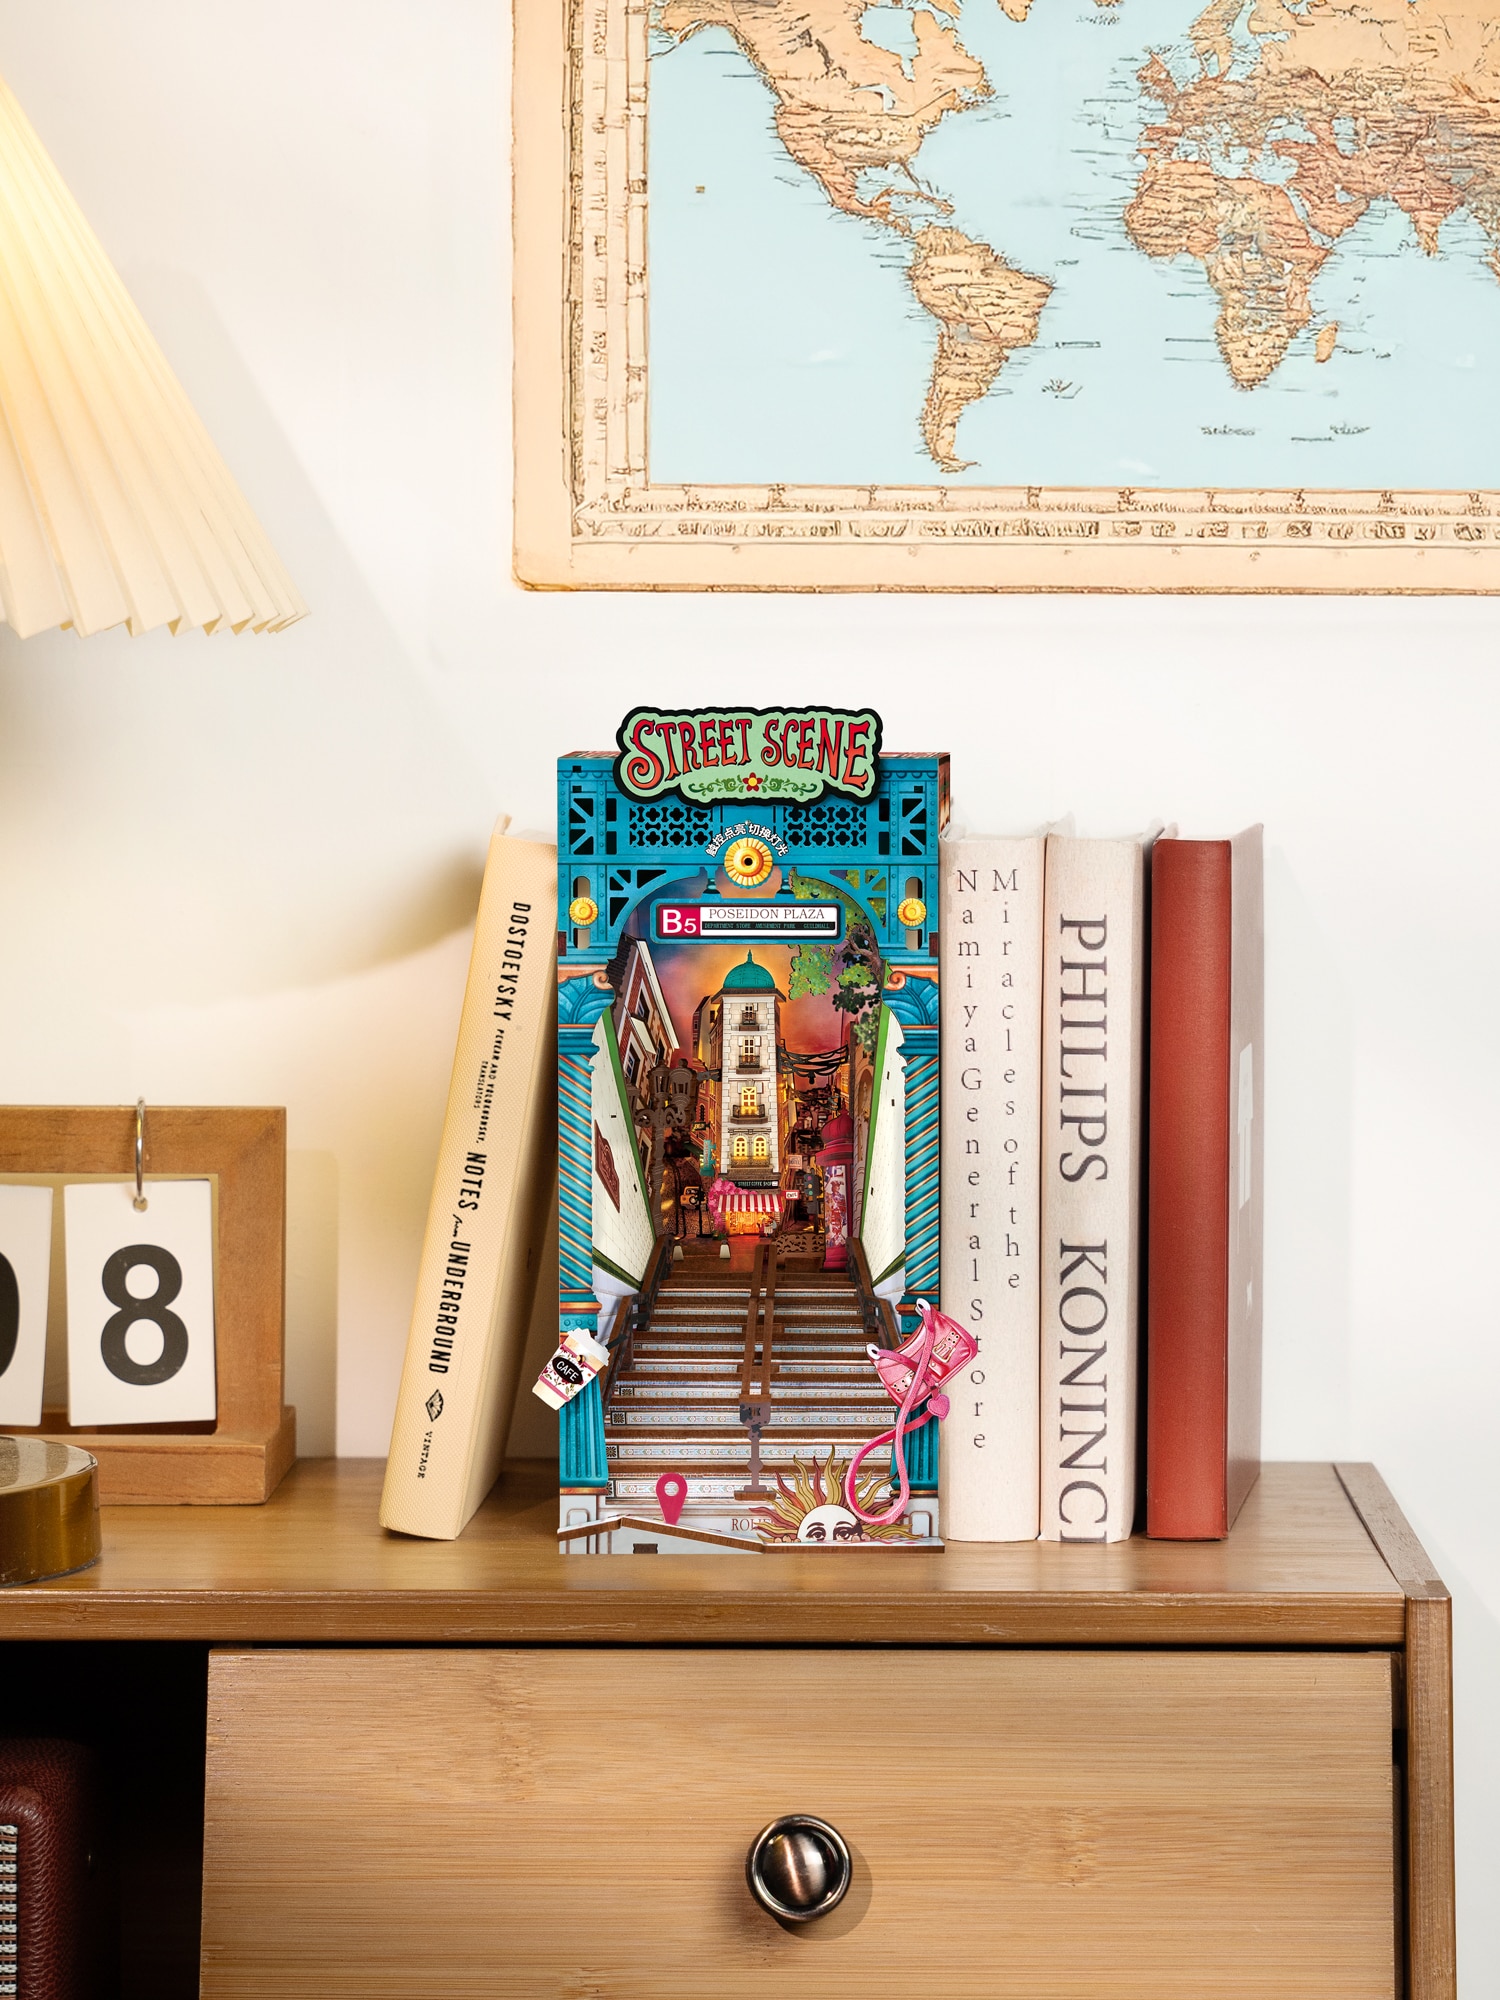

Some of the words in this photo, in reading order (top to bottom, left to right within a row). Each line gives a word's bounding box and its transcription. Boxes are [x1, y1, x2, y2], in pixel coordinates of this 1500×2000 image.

[626, 717, 753, 790] STREET
[760, 717, 870, 790] SCENE
[662, 909, 697, 934] B5
[708, 908, 780, 919] POSEIDON
[783, 908, 825, 919] PLAZA
[493, 902, 531, 1021] DOSTOEVSKY
[992, 868, 1018, 1116] Miracles
[488, 1062, 498, 1080] AND
[492, 1028, 505, 1061] PEVEAR
[1059, 913, 1108, 1183] PHILIPS
[473, 1060, 489, 1109] TRANSLATORS
[457, 1151, 487, 1211] NOTES
[1003, 1139, 1019, 1185] of
[1005, 1207, 1020, 1289] the
[100, 1244, 189, 1386] 8
[428, 1241, 471, 1374] UNDERGROUND
[556, 1361, 579, 1382] CAFE
[1058, 1238, 1108, 1543] KONINC
[417, 1431, 433, 1479] VINTAGE
